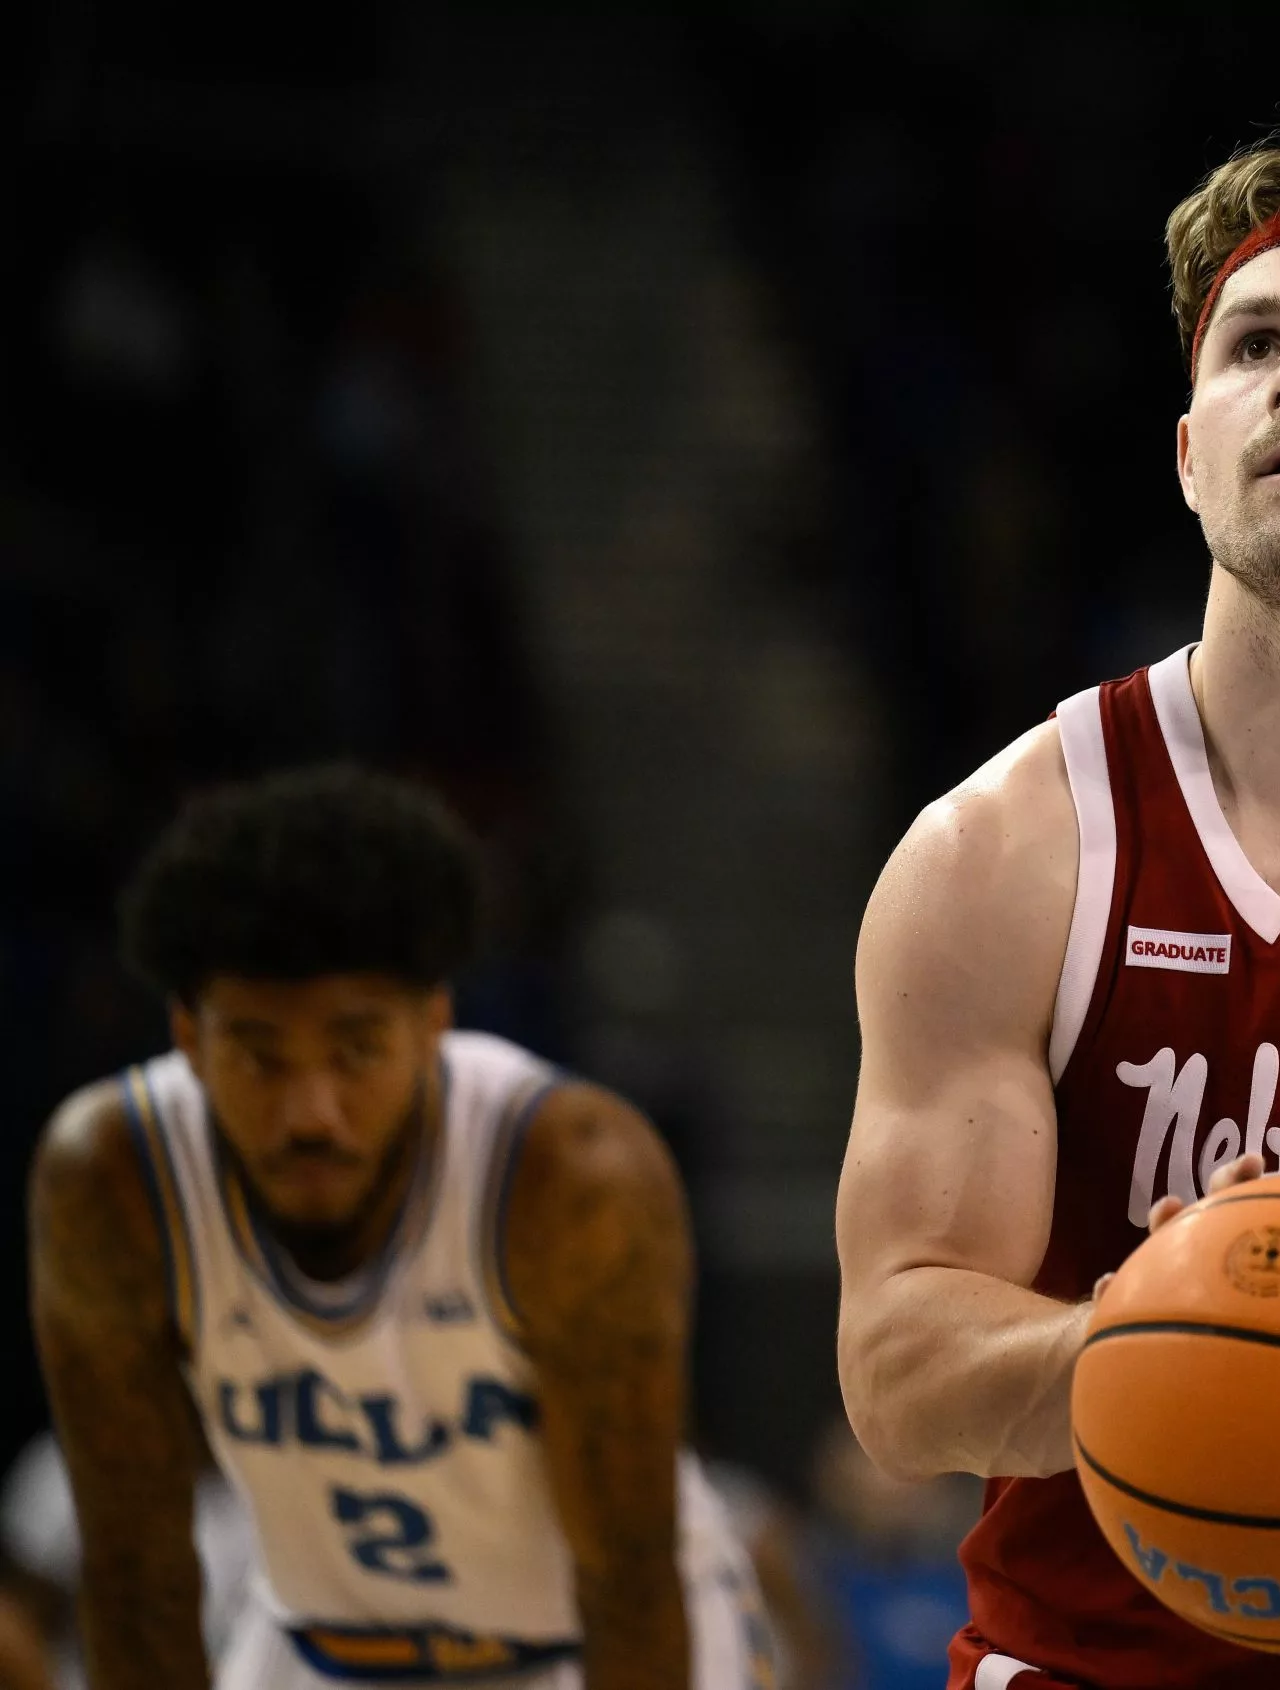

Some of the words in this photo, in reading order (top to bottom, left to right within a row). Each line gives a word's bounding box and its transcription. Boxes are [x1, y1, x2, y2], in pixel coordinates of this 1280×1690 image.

[1131, 940, 1227, 963] GRADUATE
[217, 1367, 542, 1466] UCLA
[329, 1482, 453, 1586] 2
